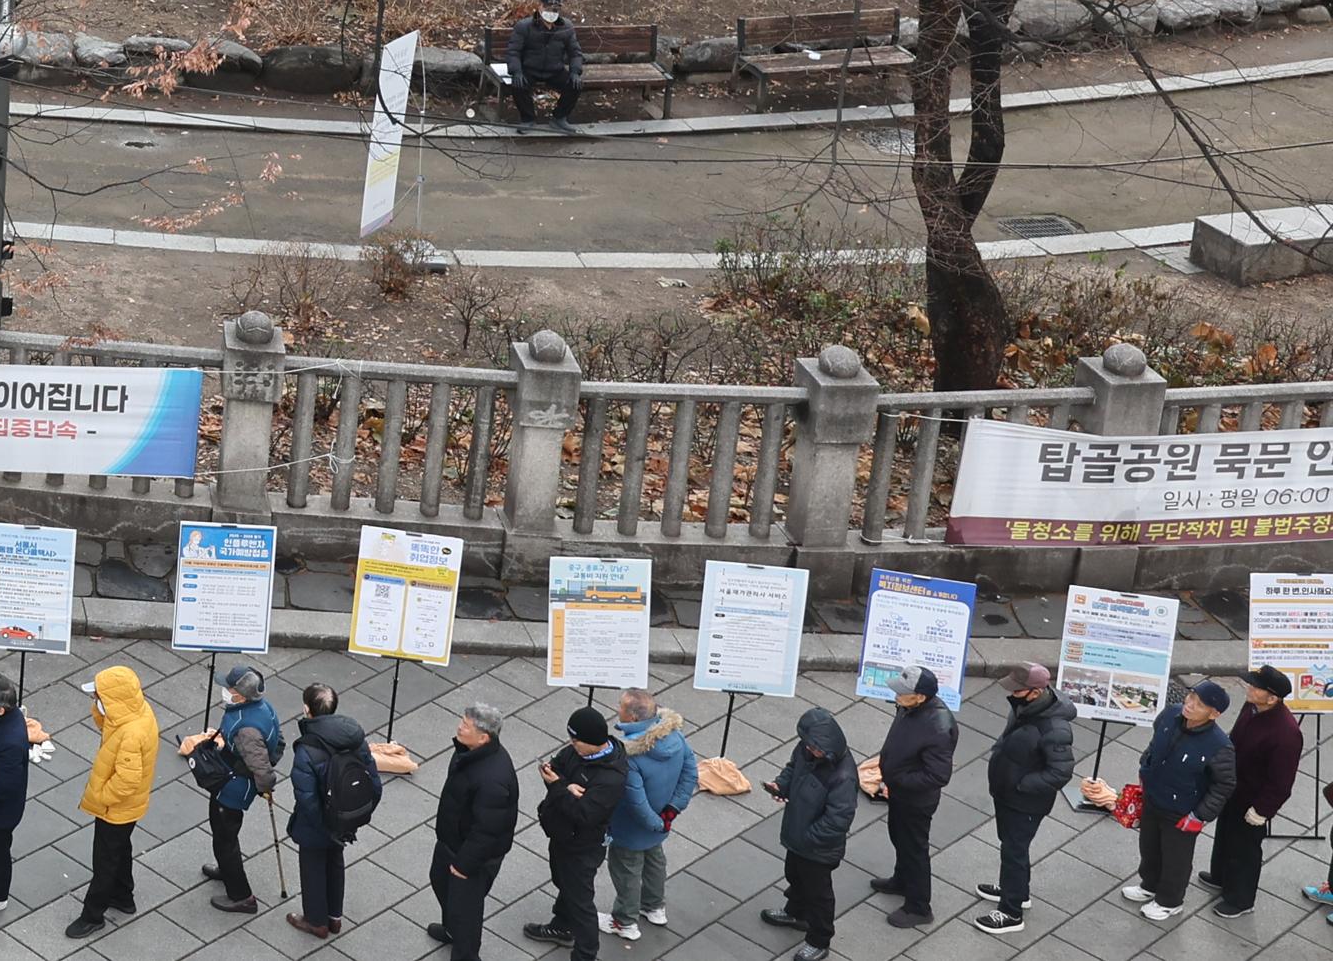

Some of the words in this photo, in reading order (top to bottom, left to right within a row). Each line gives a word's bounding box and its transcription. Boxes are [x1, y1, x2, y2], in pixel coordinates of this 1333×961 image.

[1038, 442, 1202, 484] 탑골공원
[1164, 491, 1201, 511] 일시
[1220, 489, 1258, 509] 평일
[1263, 486, 1330, 506] 06:00
[1099, 523, 1140, 542] 위해
[1145, 519, 1224, 541] 무단적치
[1228, 518, 1249, 538] 및
[1253, 514, 1333, 537] 불법주정
